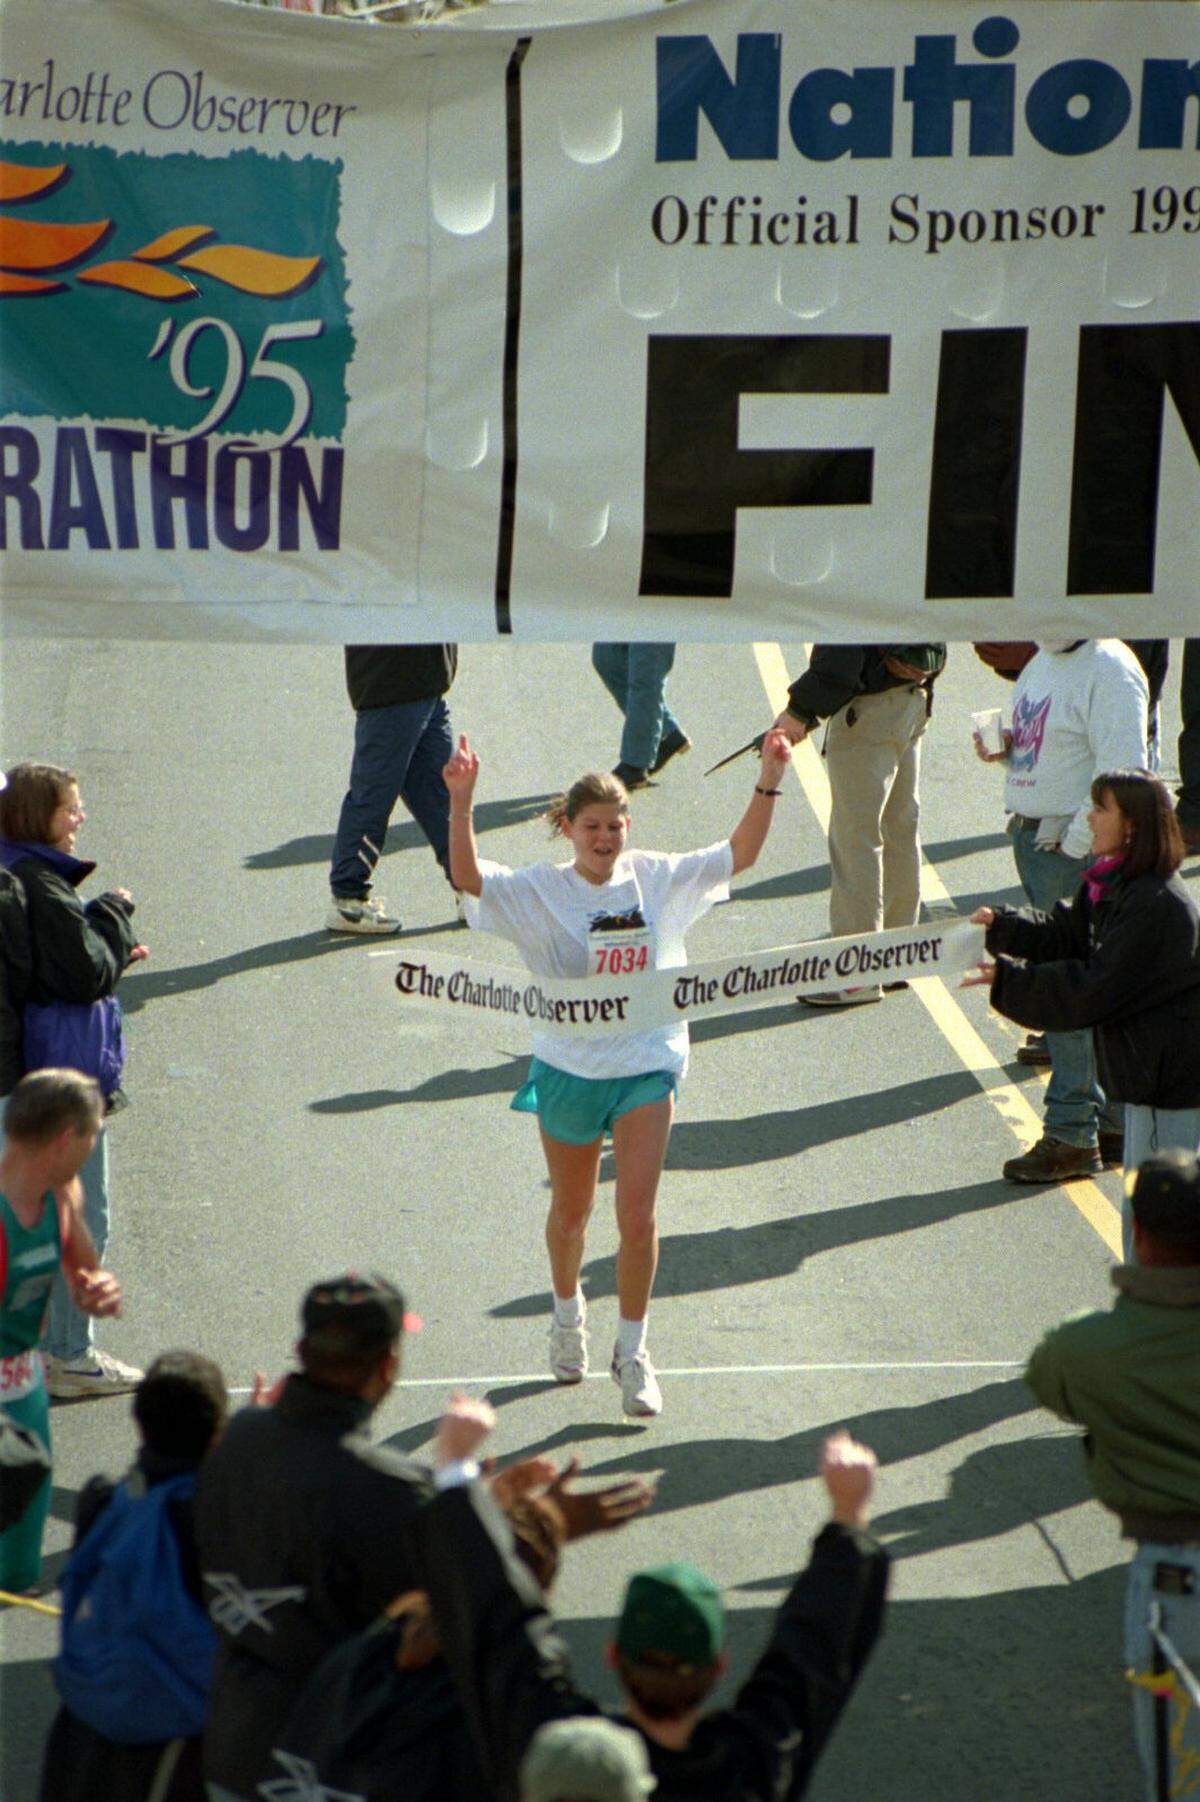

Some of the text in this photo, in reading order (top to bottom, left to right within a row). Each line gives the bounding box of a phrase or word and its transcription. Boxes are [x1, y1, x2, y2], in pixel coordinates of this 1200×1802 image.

[0, 59, 356, 138] arlotte Observer
[651, 194, 859, 246] Official
[888, 193, 1106, 254] Sponsor
[148, 316, 324, 453] '95
[0, 425, 345, 552] RATHON
[395, 961, 629, 1023] The Charlotte Observer
[595, 945, 648, 975] 7034
[673, 936, 942, 1009] The Charlotte Observer
